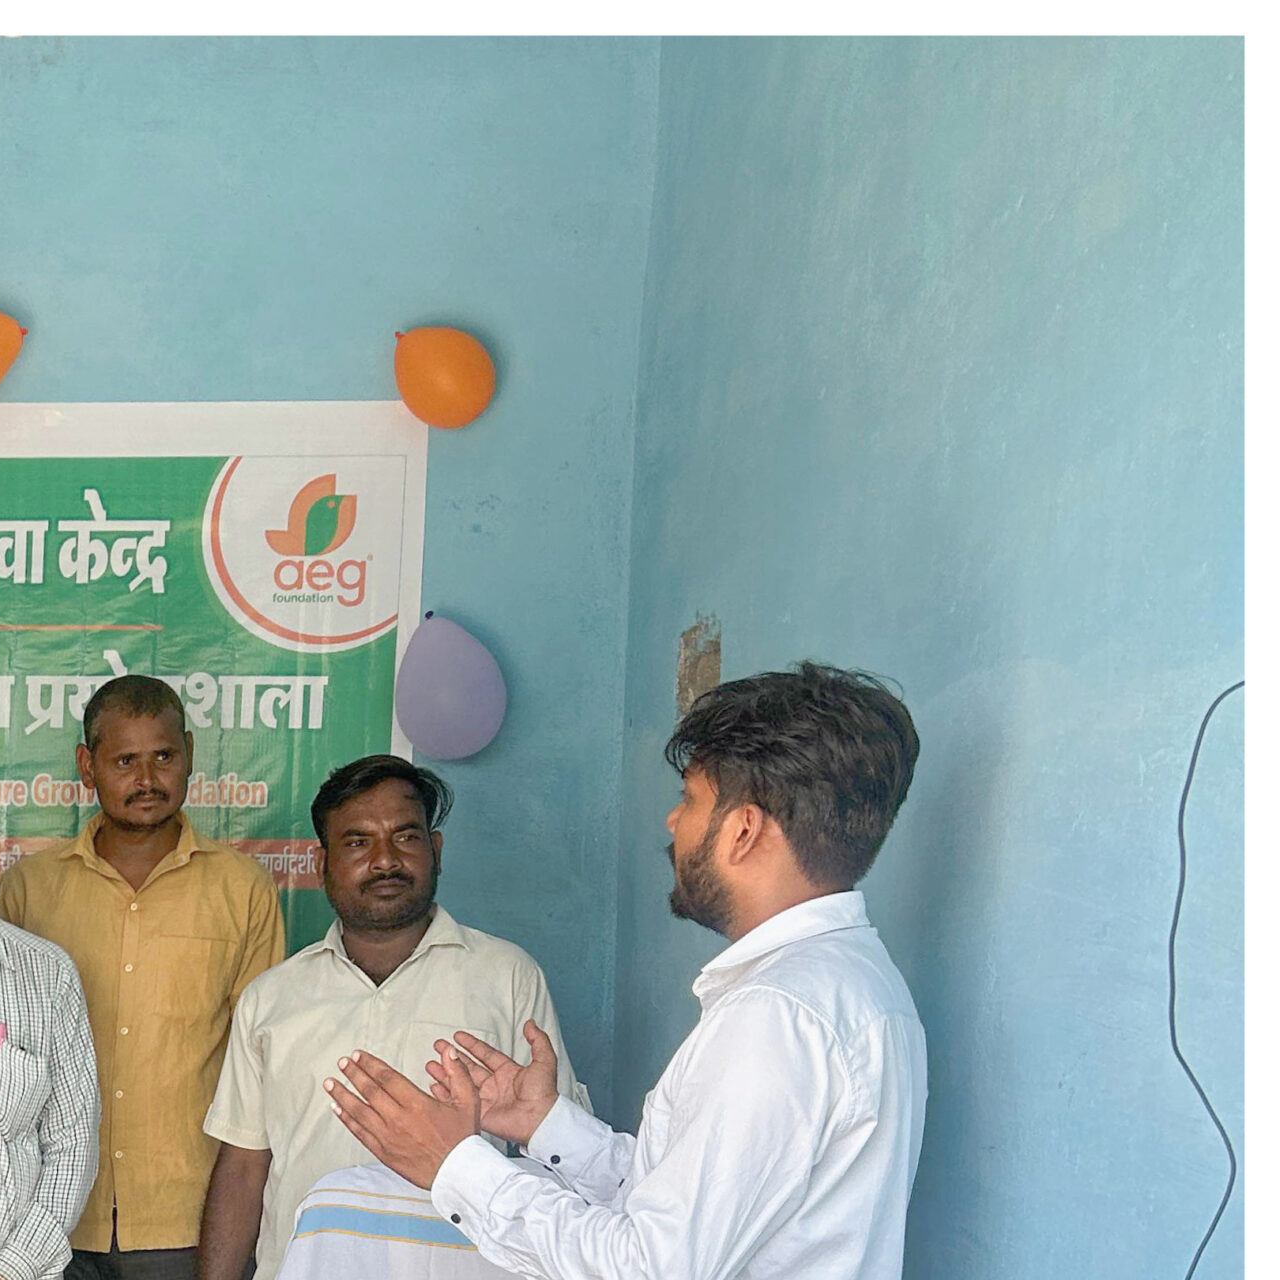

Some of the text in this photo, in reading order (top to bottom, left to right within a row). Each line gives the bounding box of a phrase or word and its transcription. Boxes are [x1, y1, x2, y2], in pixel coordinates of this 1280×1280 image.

[58, 489, 170, 593] केन्द्र
[272, 593, 334, 603] foundation
[273, 559, 367, 607] aeg
